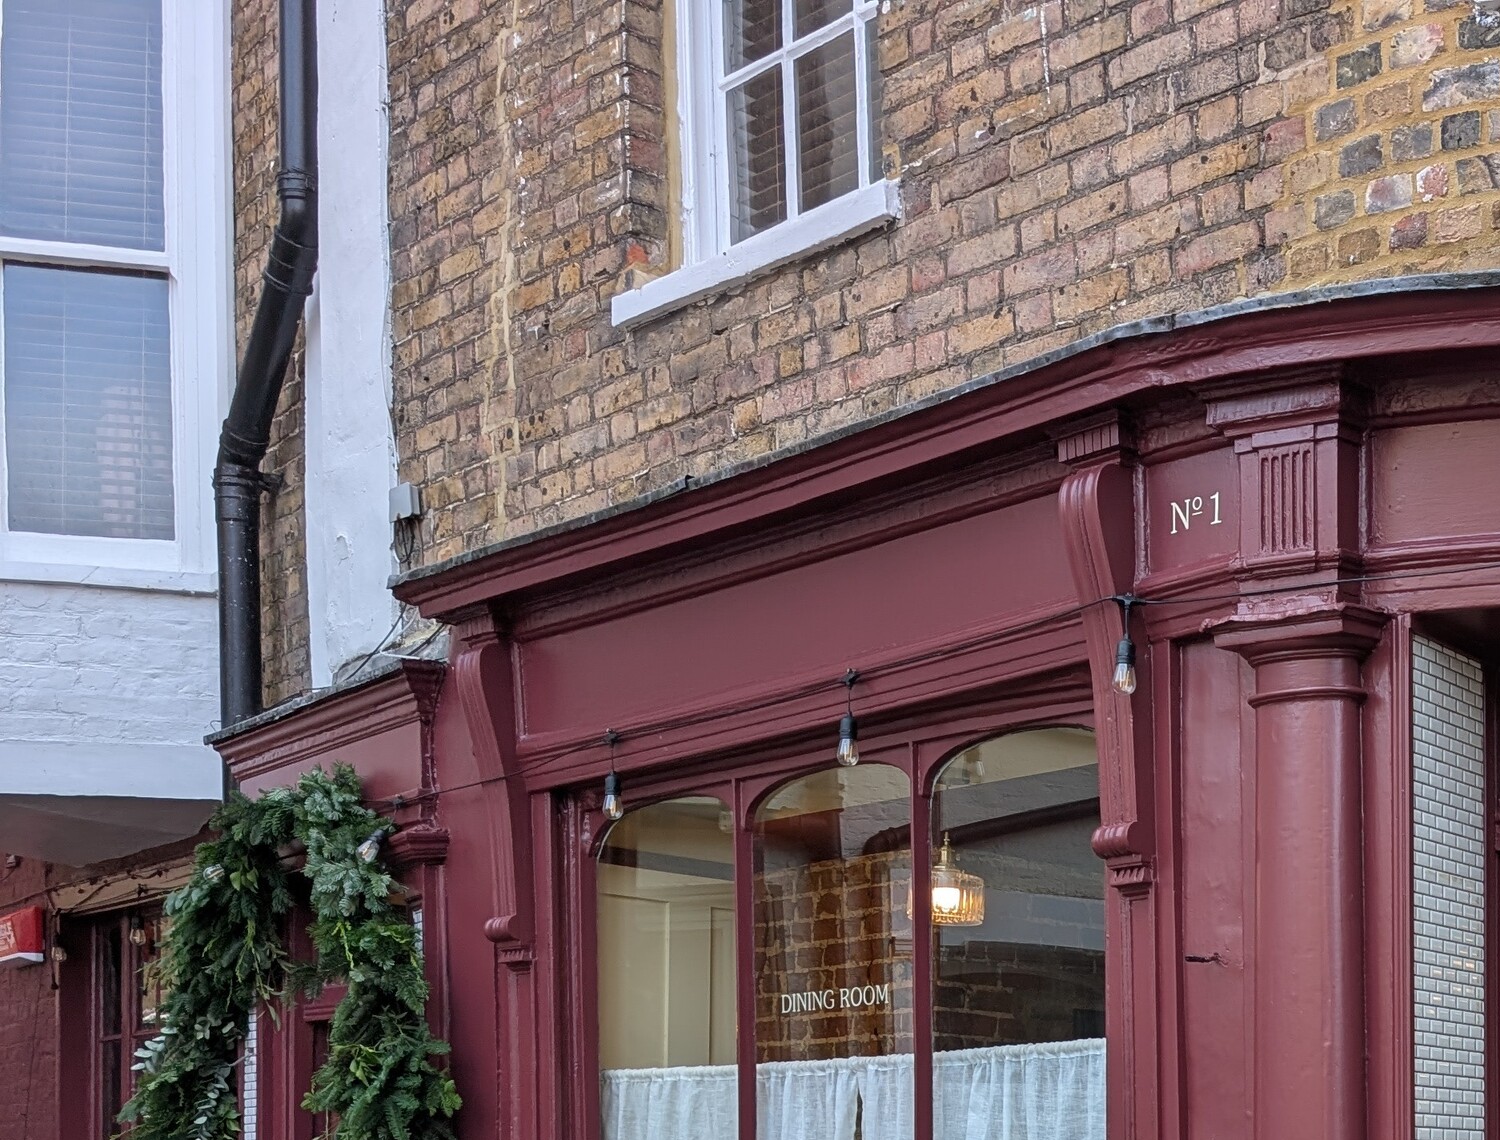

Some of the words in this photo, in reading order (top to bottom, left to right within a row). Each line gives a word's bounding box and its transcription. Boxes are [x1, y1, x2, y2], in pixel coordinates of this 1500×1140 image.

[1210, 491, 1222, 525] 1
[781, 989, 835, 1013] DINING
[839, 984, 889, 1008] ROOM
